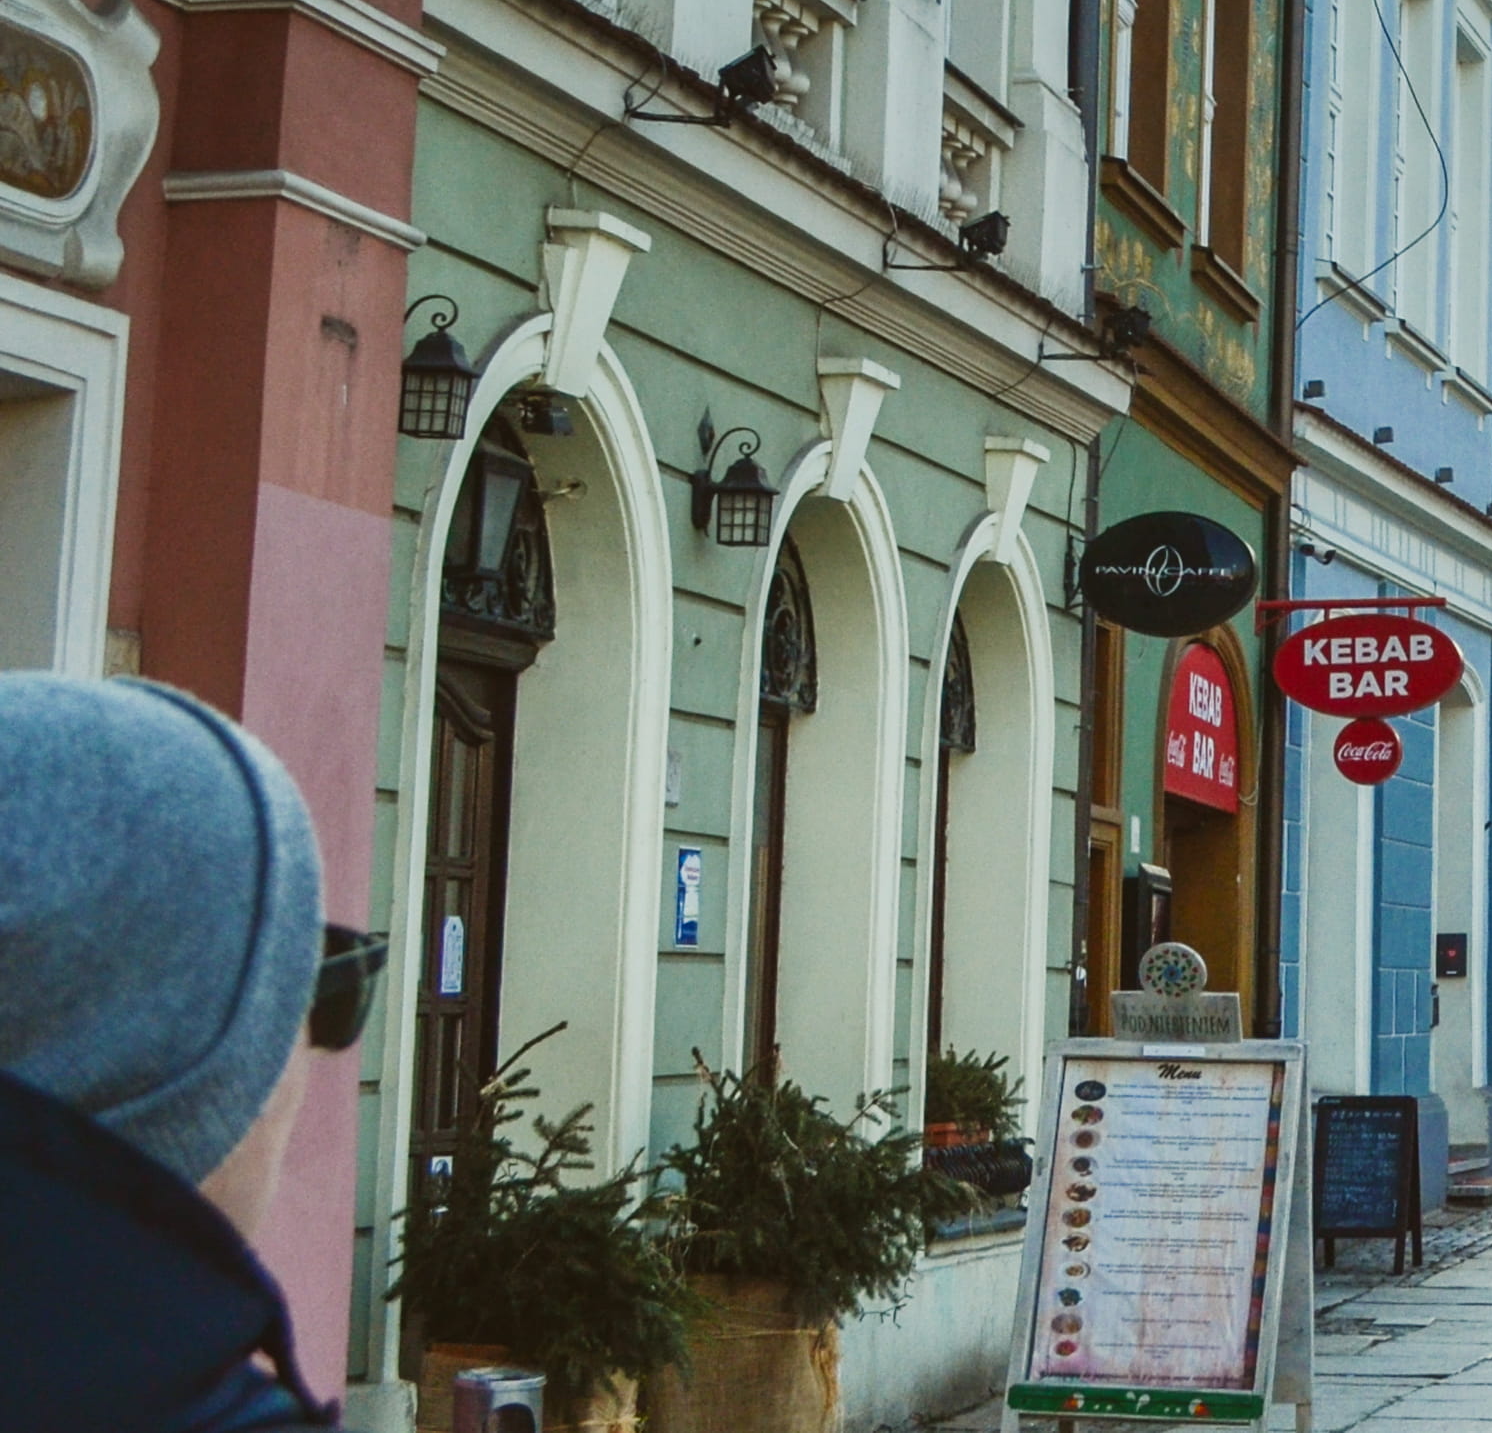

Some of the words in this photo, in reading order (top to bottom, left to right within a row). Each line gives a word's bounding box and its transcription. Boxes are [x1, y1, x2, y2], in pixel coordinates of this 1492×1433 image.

[1303, 634, 1434, 666] KEBAB
[1189, 672, 1223, 728] KEBAB
[1329, 670, 1409, 699] BAR
[1191, 731, 1215, 780] BAR
[1157, 1063, 1202, 1080] Menu
